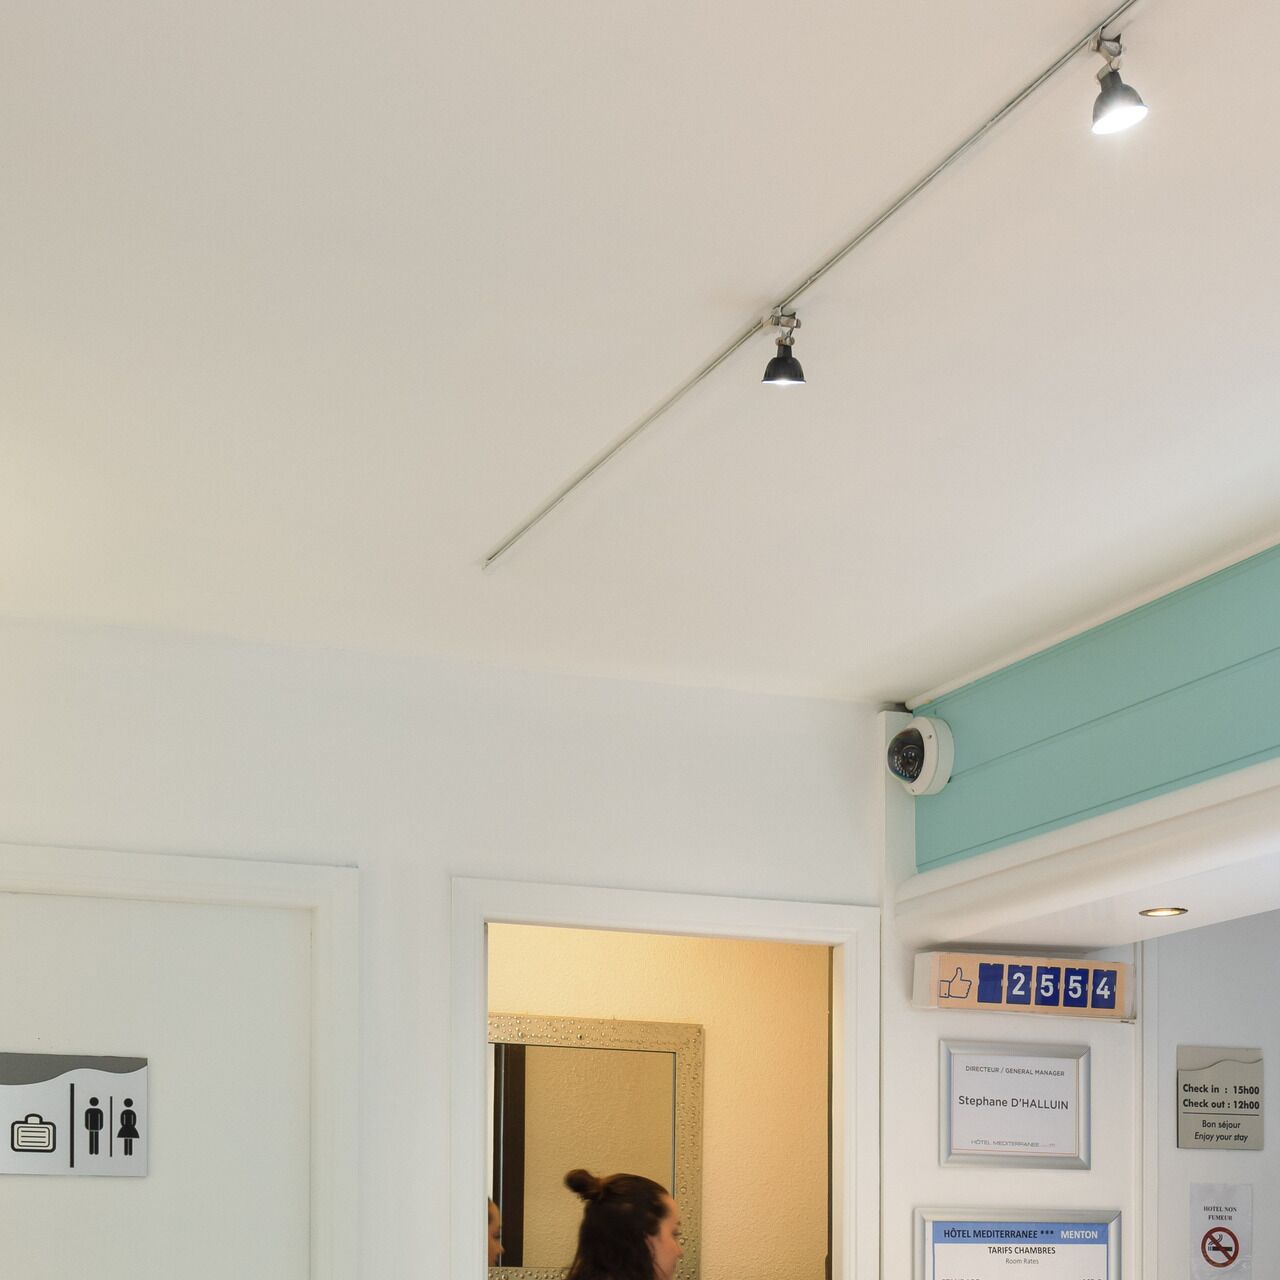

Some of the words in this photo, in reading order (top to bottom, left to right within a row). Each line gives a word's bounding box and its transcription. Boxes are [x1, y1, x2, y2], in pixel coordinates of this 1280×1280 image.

[965, 1065, 999, 1073] DIRECTEUR
[1034, 1069, 1065, 1077] MANAGER
[1182, 1083, 1209, 1093] Check
[1211, 1084, 1220, 1093] in
[1233, 1085, 1260, 1095] 15h00
[958, 1095, 1008, 1108] Stephane
[1011, 1098, 1069, 1110] D'HALLUIN
[1182, 1099, 1209, 1108] Check
[1211, 1100, 1225, 1109] out
[1233, 1100, 1260, 1110] 12h00
[1202, 1119, 1216, 1128] Bon
[1218, 1120, 1241, 1130] séjour
[1194, 1131, 1214, 1142] Enjoy
[1215, 1133, 1232, 1142] your
[1233, 1133, 1249, 1143] stay
[943, 1227, 971, 1239] HÔTEL
[972, 1229, 1038, 1239] MEDITERRANEE
[1060, 1230, 1098, 1240] MENTON
[988, 1246, 1013, 1255] TARIFS
[1014, 1246, 1056, 1255] CHAMBRES
[1005, 1257, 1022, 1265] Room
[1023, 1257, 1040, 1265] Rates
